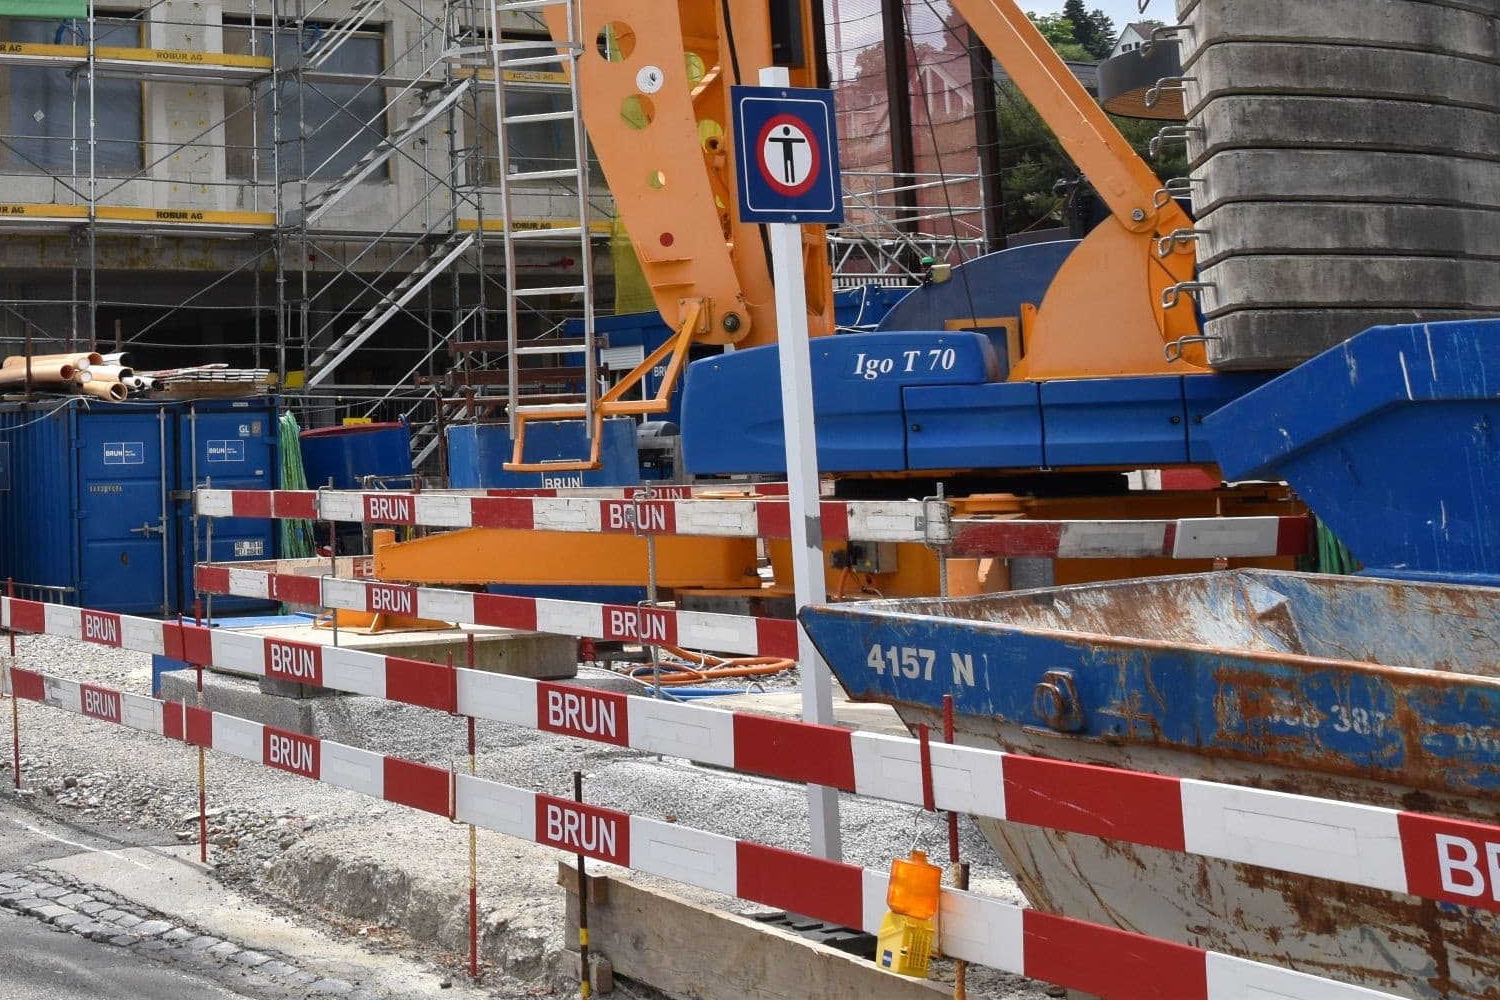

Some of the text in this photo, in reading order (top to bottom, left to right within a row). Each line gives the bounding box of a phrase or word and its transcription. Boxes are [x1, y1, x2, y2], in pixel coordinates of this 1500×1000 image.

[9, 44, 22, 52] AG
[156, 51, 187, 60] ROBUR
[11, 206, 24, 214] AG
[156, 211, 203, 220] ROBUR AG
[540, 222, 551, 230] AG
[853, 348, 956, 380] Igo T 70
[239, 424, 249, 433] GL
[544, 477, 581, 488] BRUN
[369, 497, 409, 521] BRUN
[372, 587, 411, 613] BRUN
[85, 614, 116, 642] BRUN
[611, 610, 666, 641] BRUN
[270, 643, 315, 679] BRUN
[867, 644, 975, 687] 4157 N
[85, 689, 116, 719] BRUN
[548, 690, 616, 738] BRUN
[269, 734, 313, 773] BRUN
[547, 804, 616, 857] BRUN
